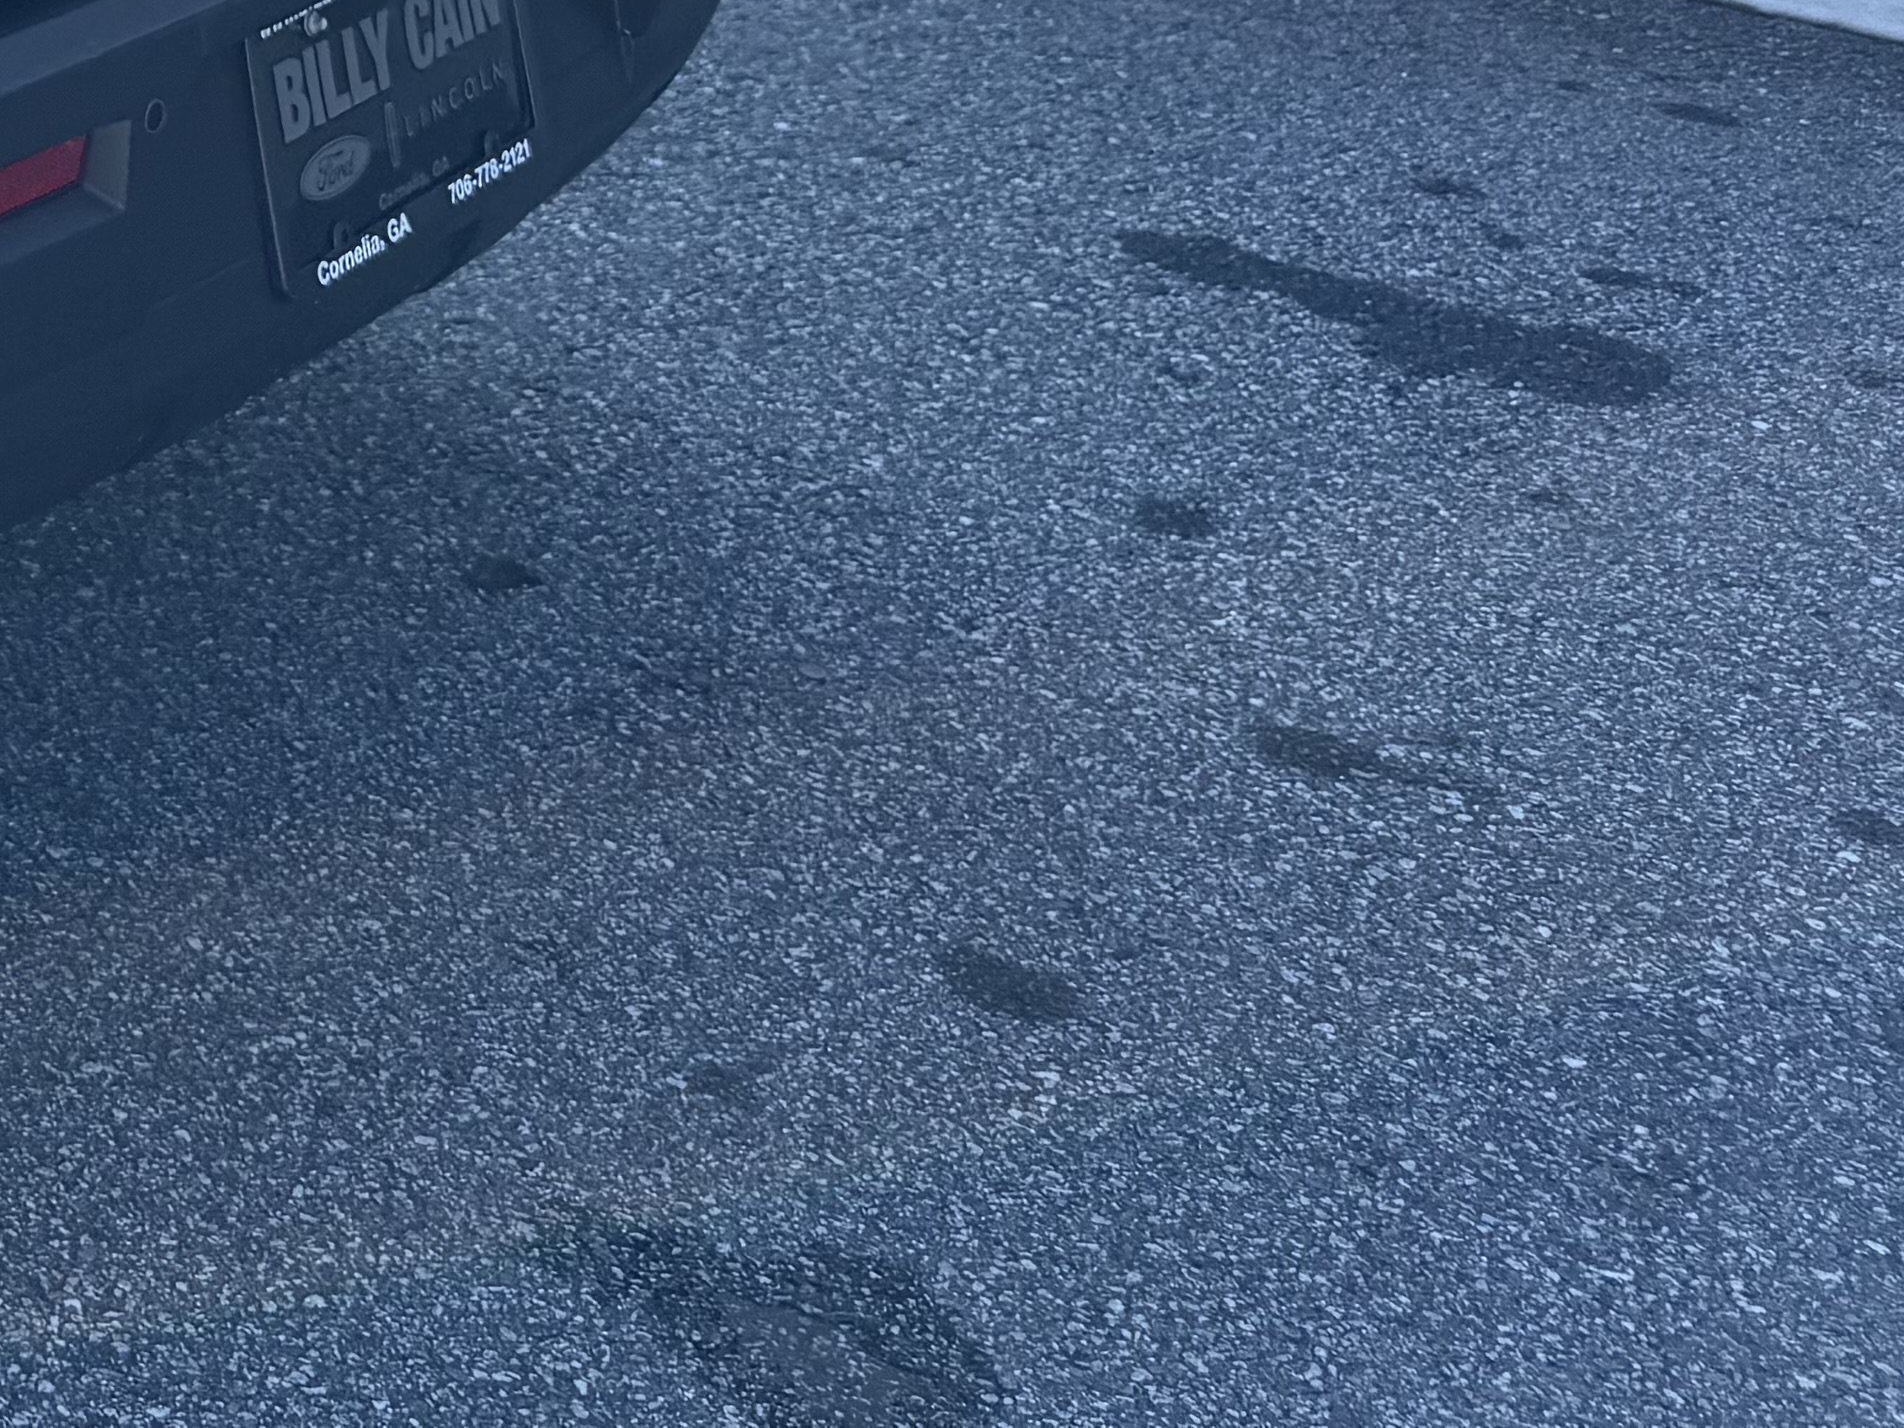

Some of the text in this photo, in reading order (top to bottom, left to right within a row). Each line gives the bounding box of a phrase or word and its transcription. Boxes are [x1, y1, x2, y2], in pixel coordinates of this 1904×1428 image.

[273, 7, 392, 144] BILLY
[402, 57, 508, 137] LINCOLN
[316, 149, 354, 192] Ford
[448, 139, 532, 204] 706-778-2121
[317, 213, 413, 286] Cornelia, GA
